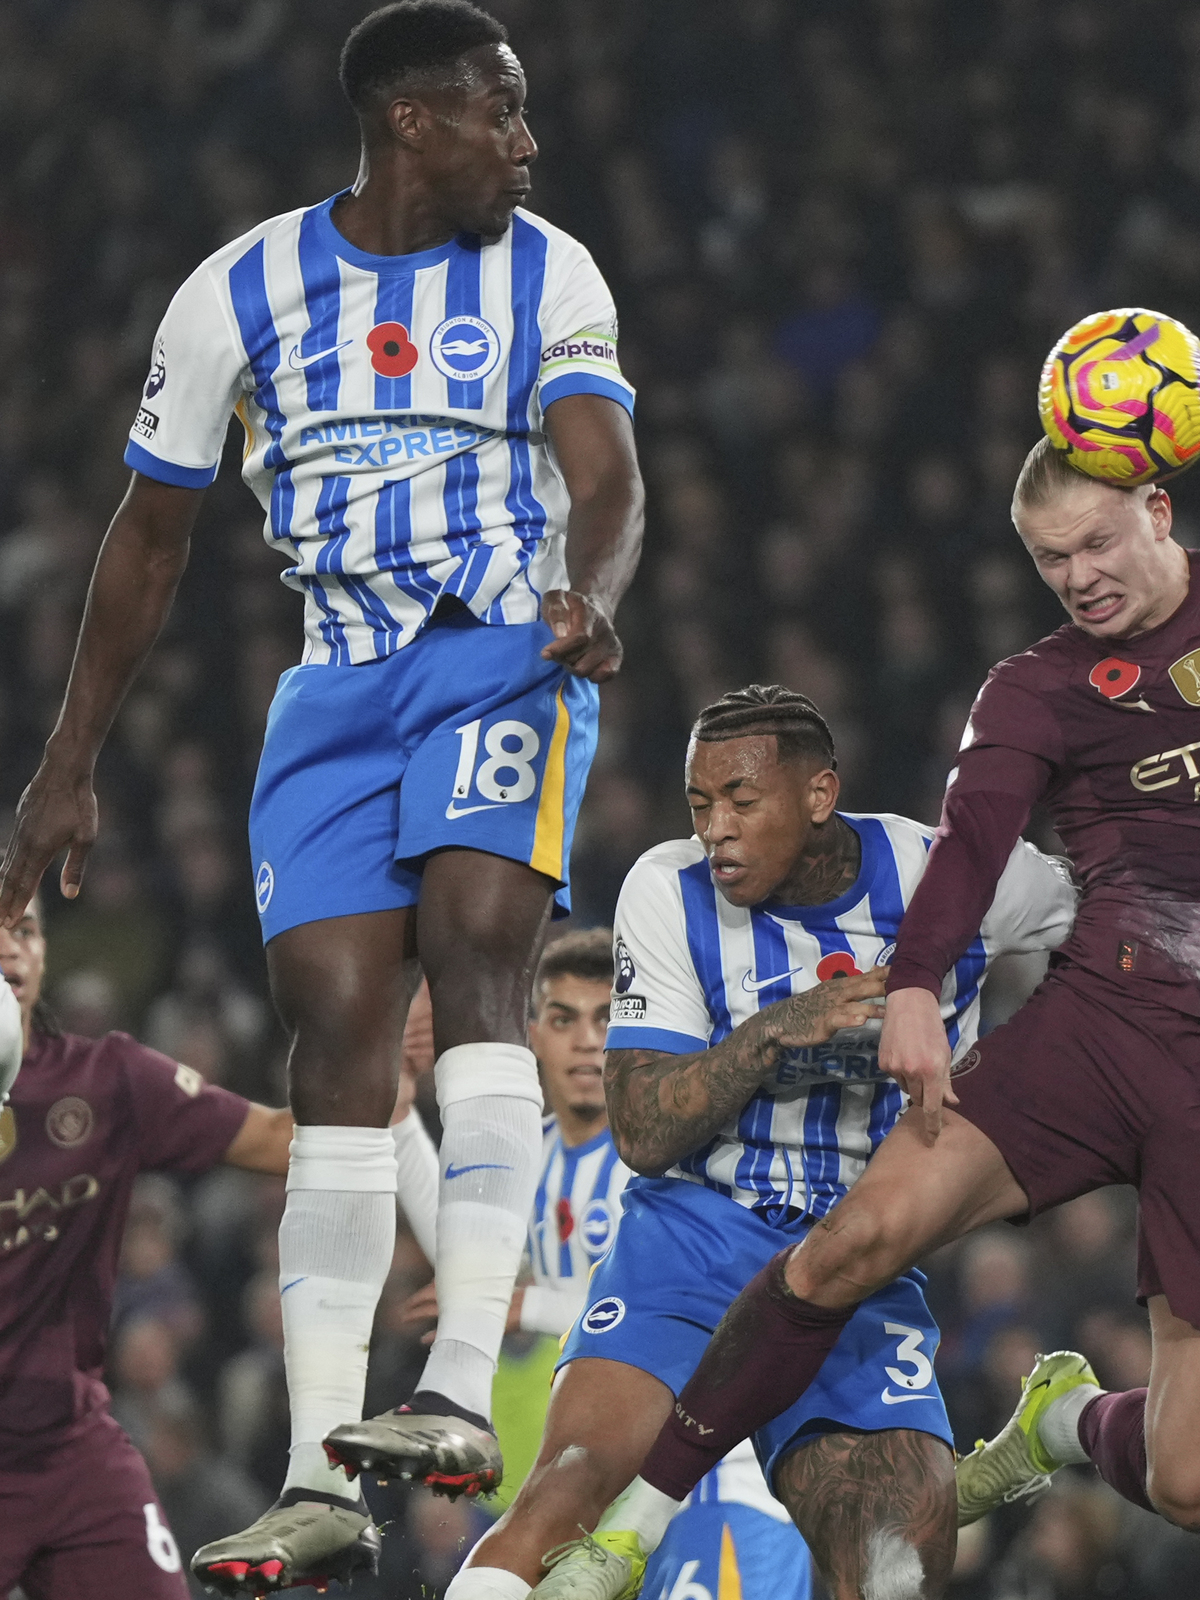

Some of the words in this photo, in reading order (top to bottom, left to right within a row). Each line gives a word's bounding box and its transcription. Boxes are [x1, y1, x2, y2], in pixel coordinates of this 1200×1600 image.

[437, 317, 466, 336] BRIGHTON
[475, 320, 491, 334] HOVE
[452, 371, 479, 379] ALBION
[452, 719, 540, 803] 18
[883, 1321, 932, 1390] 3
[143, 1502, 181, 1574] 6
